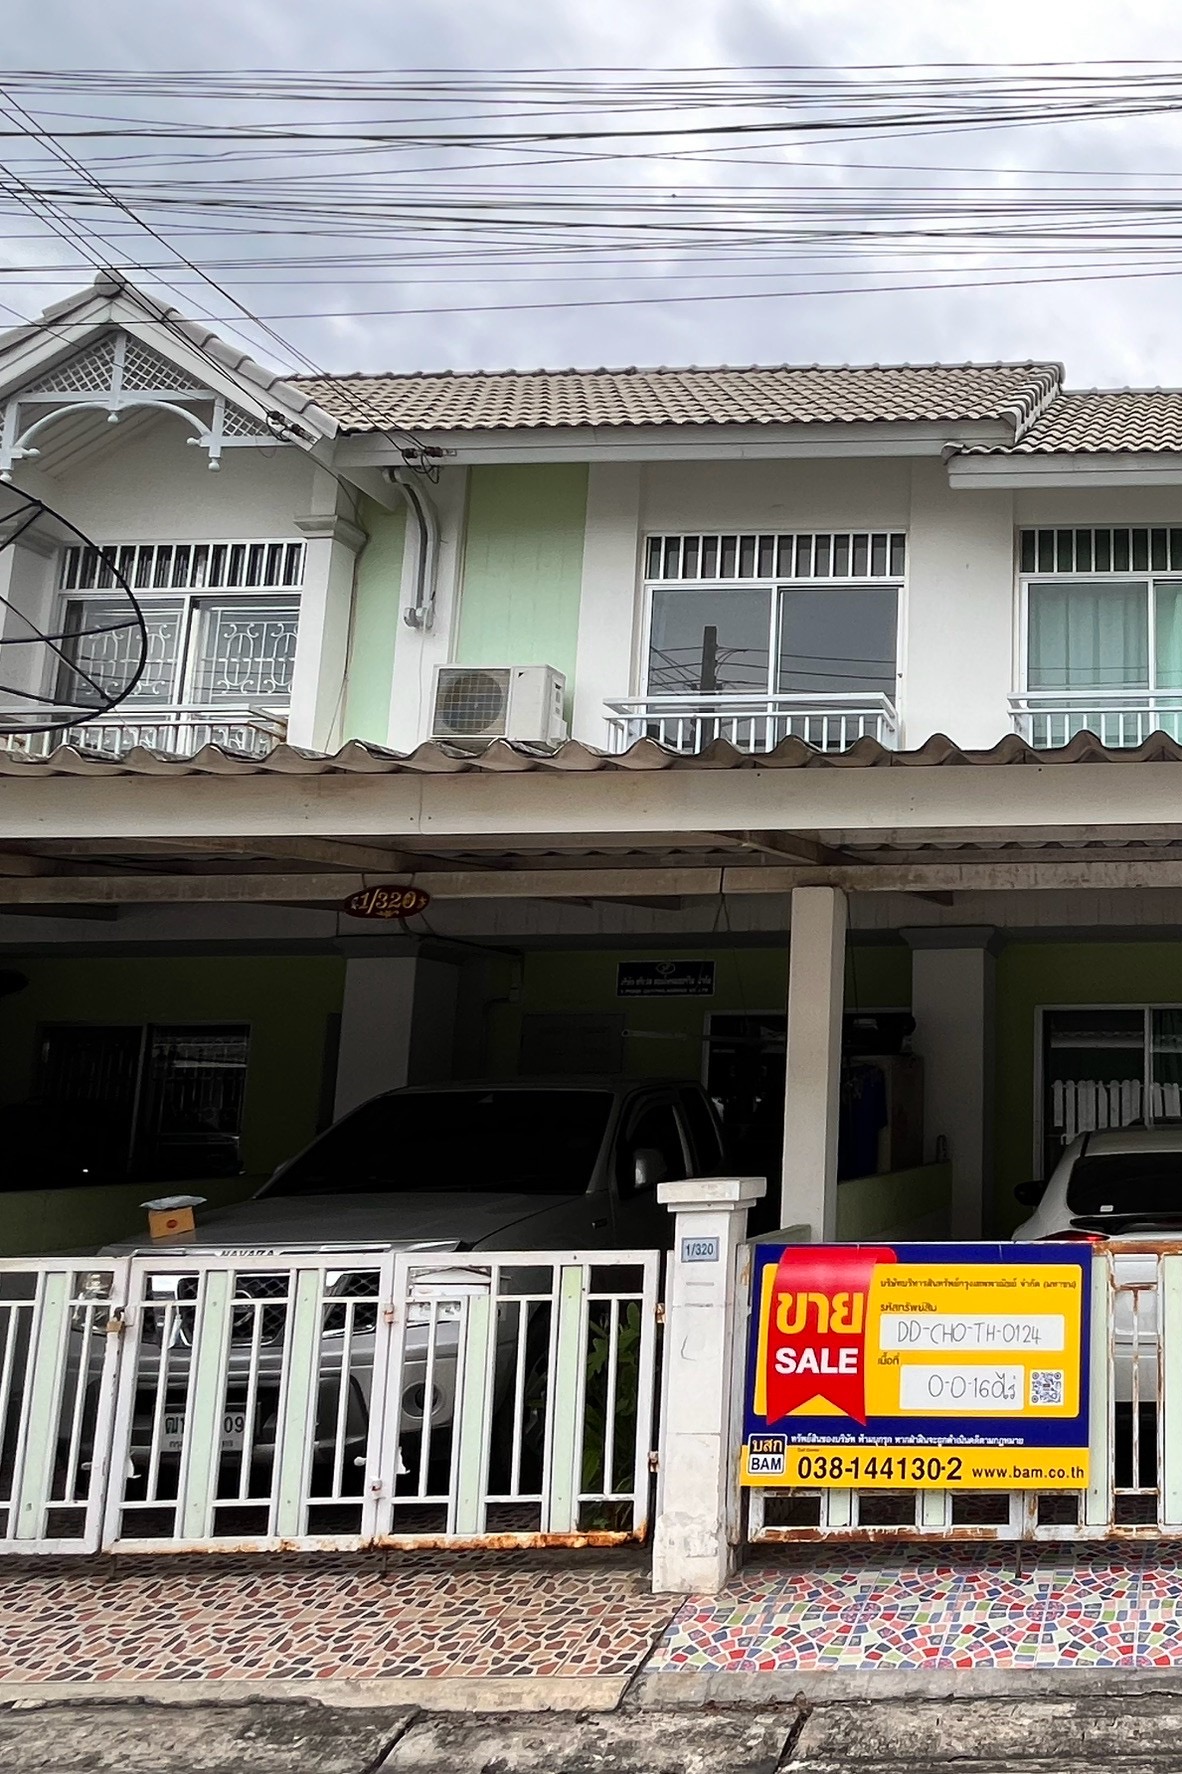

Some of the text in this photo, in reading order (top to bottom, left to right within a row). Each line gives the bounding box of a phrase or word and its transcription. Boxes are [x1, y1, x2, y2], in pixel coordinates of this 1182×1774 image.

[358, 888, 417, 914] 1/320
[686, 1243, 714, 1256] 1/320
[776, 1291, 864, 1335] ขาย
[774, 1347, 859, 1374] SALE
[752, 1438, 783, 1453] บสก
[751, 1457, 782, 1471] BAM
[972, 1466, 1084, 1479] www.bam.co.th
